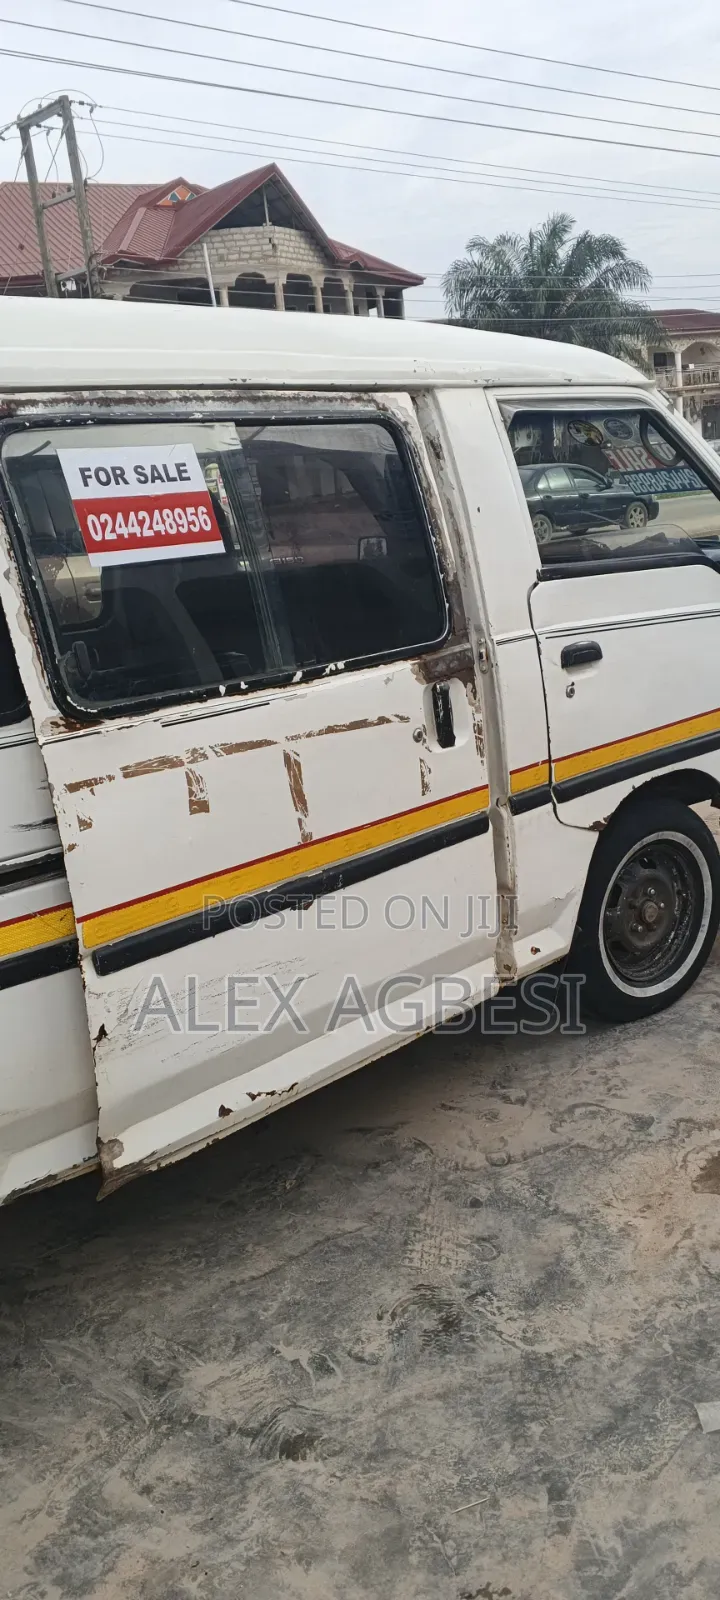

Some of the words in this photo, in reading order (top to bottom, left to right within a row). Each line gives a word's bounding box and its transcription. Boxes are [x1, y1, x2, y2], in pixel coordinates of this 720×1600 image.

[79, 467, 130, 487] FOR
[133, 463, 191, 485] SALE
[87, 506, 211, 541] 0244248956
